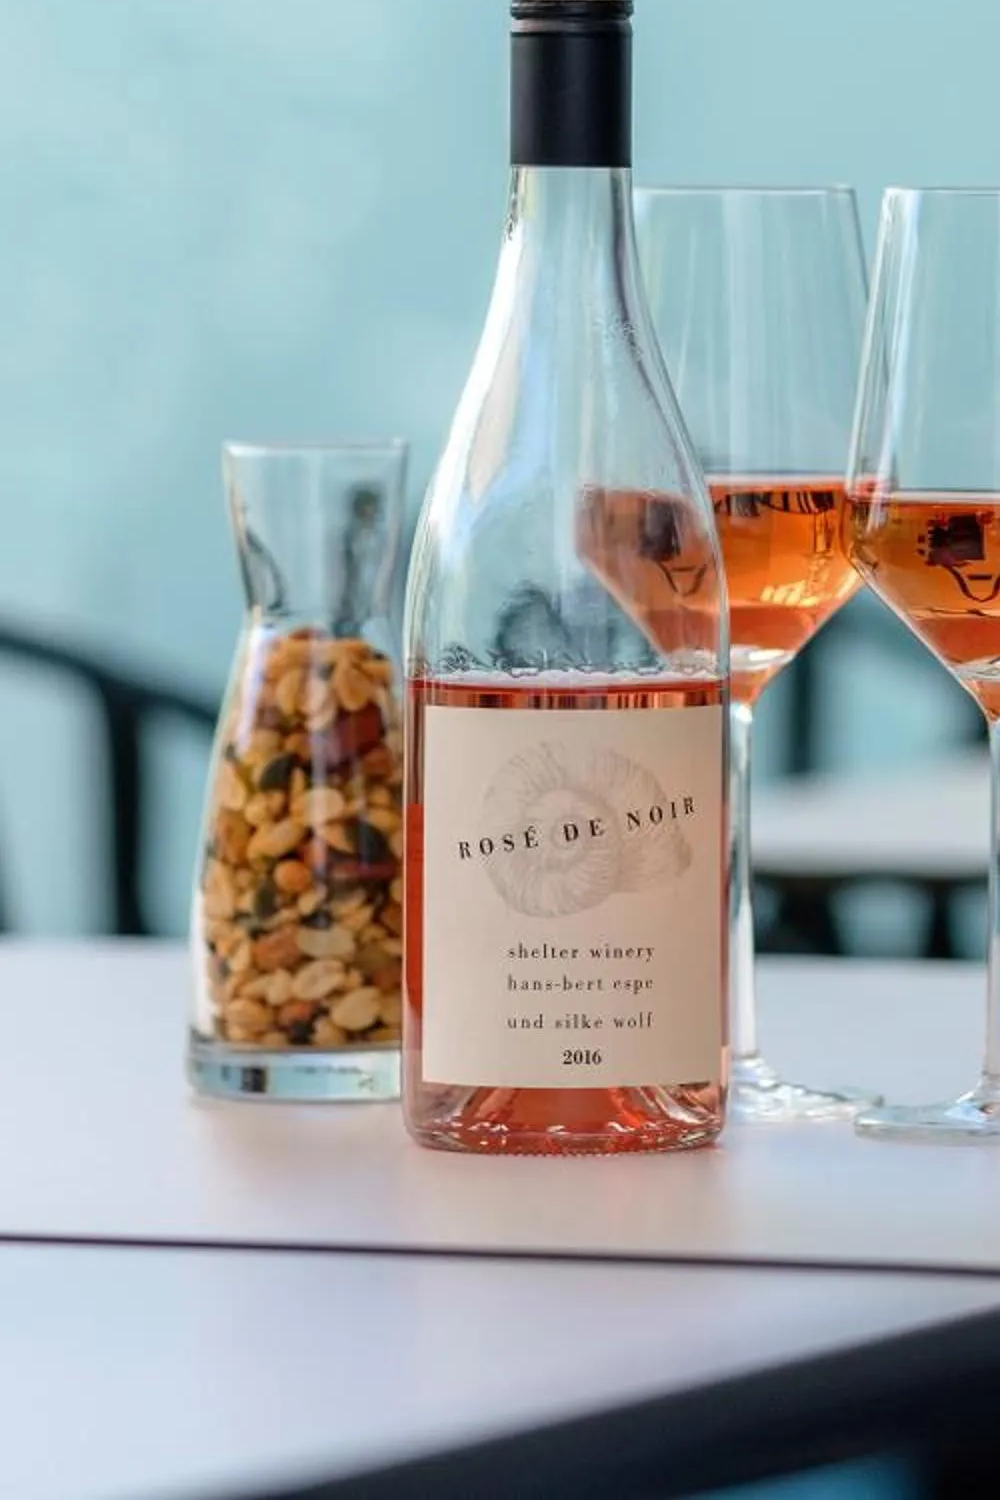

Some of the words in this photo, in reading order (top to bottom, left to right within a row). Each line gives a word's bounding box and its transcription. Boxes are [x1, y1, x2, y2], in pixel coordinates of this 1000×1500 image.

[458, 825, 540, 861] ROSÉ
[562, 817, 605, 843] DE
[626, 795, 697, 830] NOIR
[507, 943, 580, 960] shelter
[589, 944, 656, 963] winery
[507, 975, 604, 992] hans-bert
[612, 978, 655, 995] espe
[507, 1013, 545, 1030] und
[554, 1013, 604, 1030] silke
[612, 1012, 654, 1030] wolf
[562, 1049, 603, 1066] 2016
